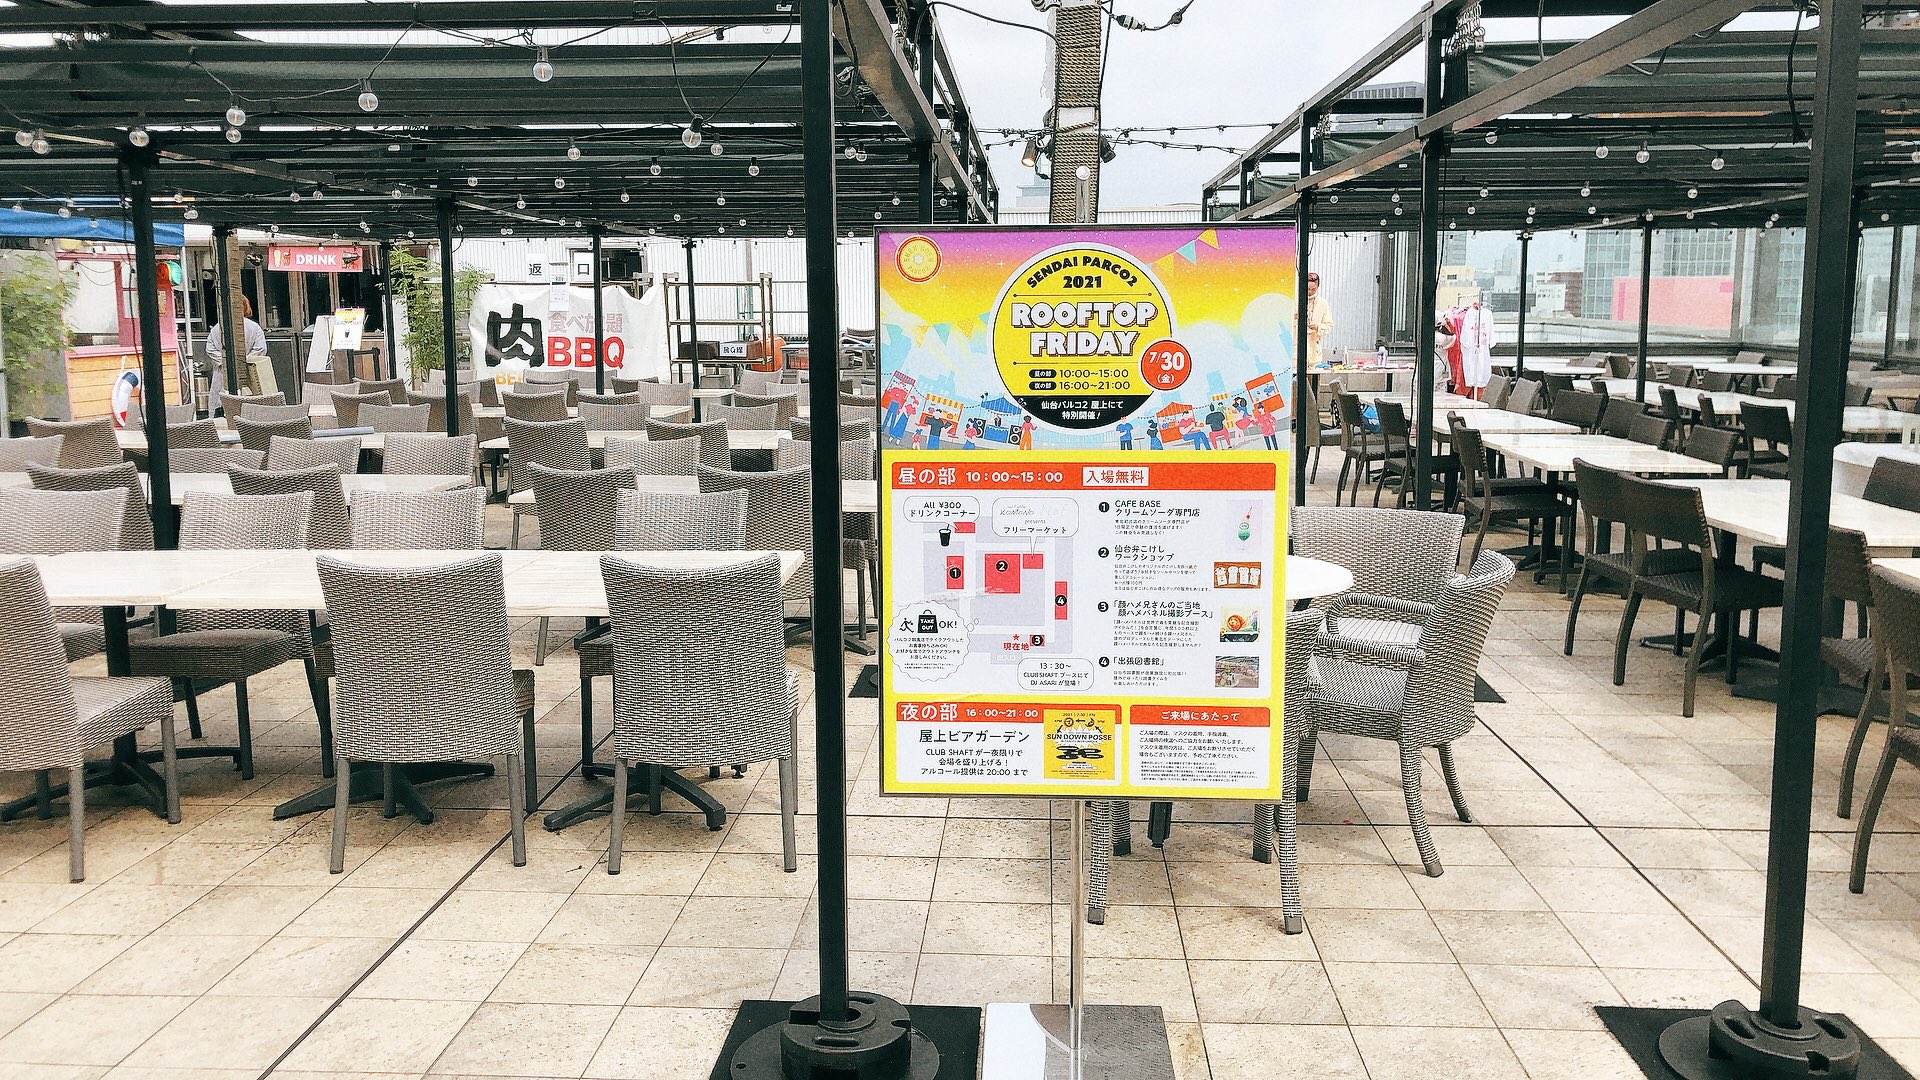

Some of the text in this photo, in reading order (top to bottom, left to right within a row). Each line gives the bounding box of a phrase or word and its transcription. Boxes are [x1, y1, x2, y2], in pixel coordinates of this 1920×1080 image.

[296, 254, 337, 265] DRINK
[1027, 256, 1138, 288] SENDAI PARCO2
[1063, 276, 1102, 288] 2021
[1011, 302, 1158, 328] ROOFTOP
[486, 303, 545, 368] 肉
[1030, 331, 1140, 357] FRIDAY
[548, 336, 624, 370] BBQ
[1149, 352, 1185, 371] 7/30
[1059, 370, 1128, 378] 10:00～15:00
[1157, 374, 1175, 384] (金)
[1059, 382, 1130, 390] 16:00～21:00
[1041, 400, 1123, 409] 仙台パルコ2 屋上にて
[1062, 412, 1101, 420] 特別開催!
[898, 466, 1145, 486] 昼の部 10:00～15:00 入場無料
[1115, 508, 1200, 517] クリームソーダ専門店
[1115, 545, 1165, 553] 仙台弁こけし
[1115, 553, 1175, 561] ワークショップ
[939, 620, 957, 629] OK!
[1003, 643, 1029, 651] 現在地
[1114, 657, 1164, 666] 「出張図書館」
[901, 703, 1038, 721] 夜の部 16:00～21:00
[1161, 711, 1240, 722] ご来場にあたって
[919, 730, 1030, 743] 屋上ビアガーデン
[939, 758, 1008, 766] 会場を盛り上げる!
